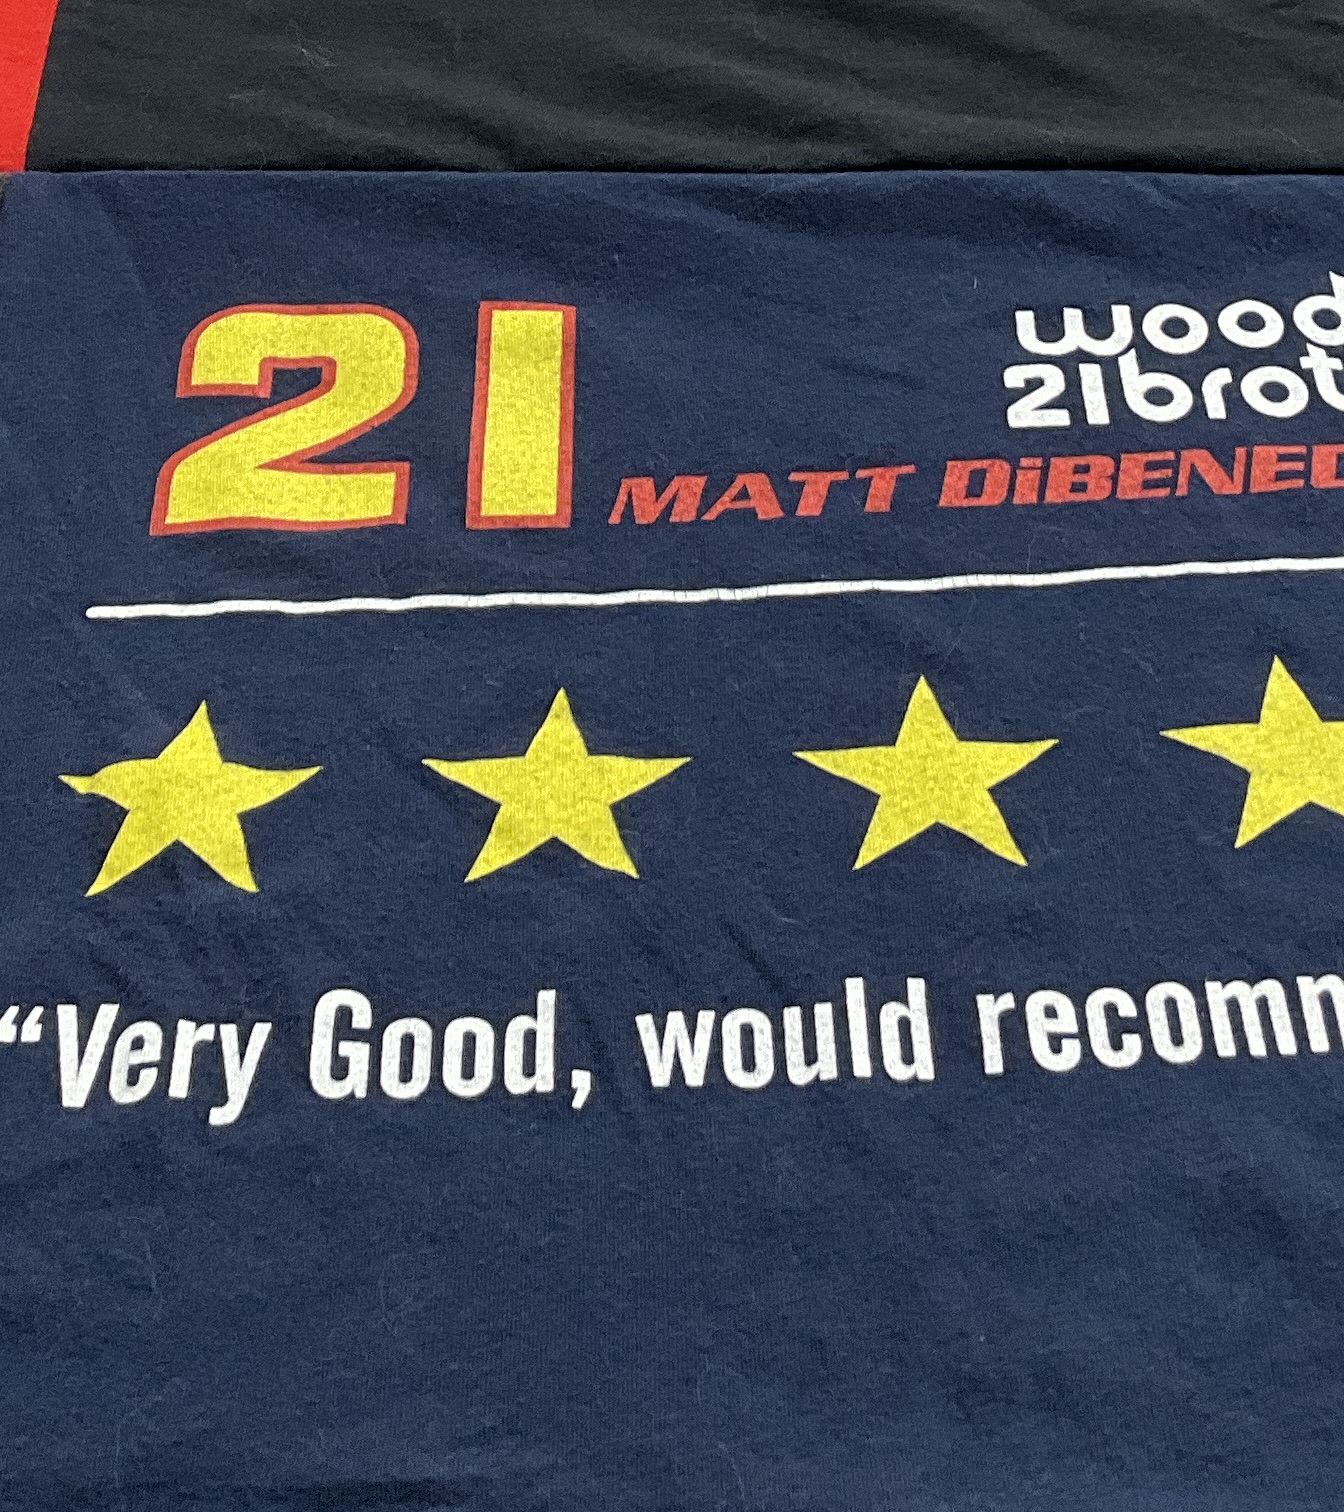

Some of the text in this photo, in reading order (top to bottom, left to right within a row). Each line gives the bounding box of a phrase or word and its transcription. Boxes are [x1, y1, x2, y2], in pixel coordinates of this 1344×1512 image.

[148, 299, 579, 537] 21
[607, 462, 919, 526] MATT
[308, 986, 593, 1112] Good,
[634, 976, 938, 1094] would
